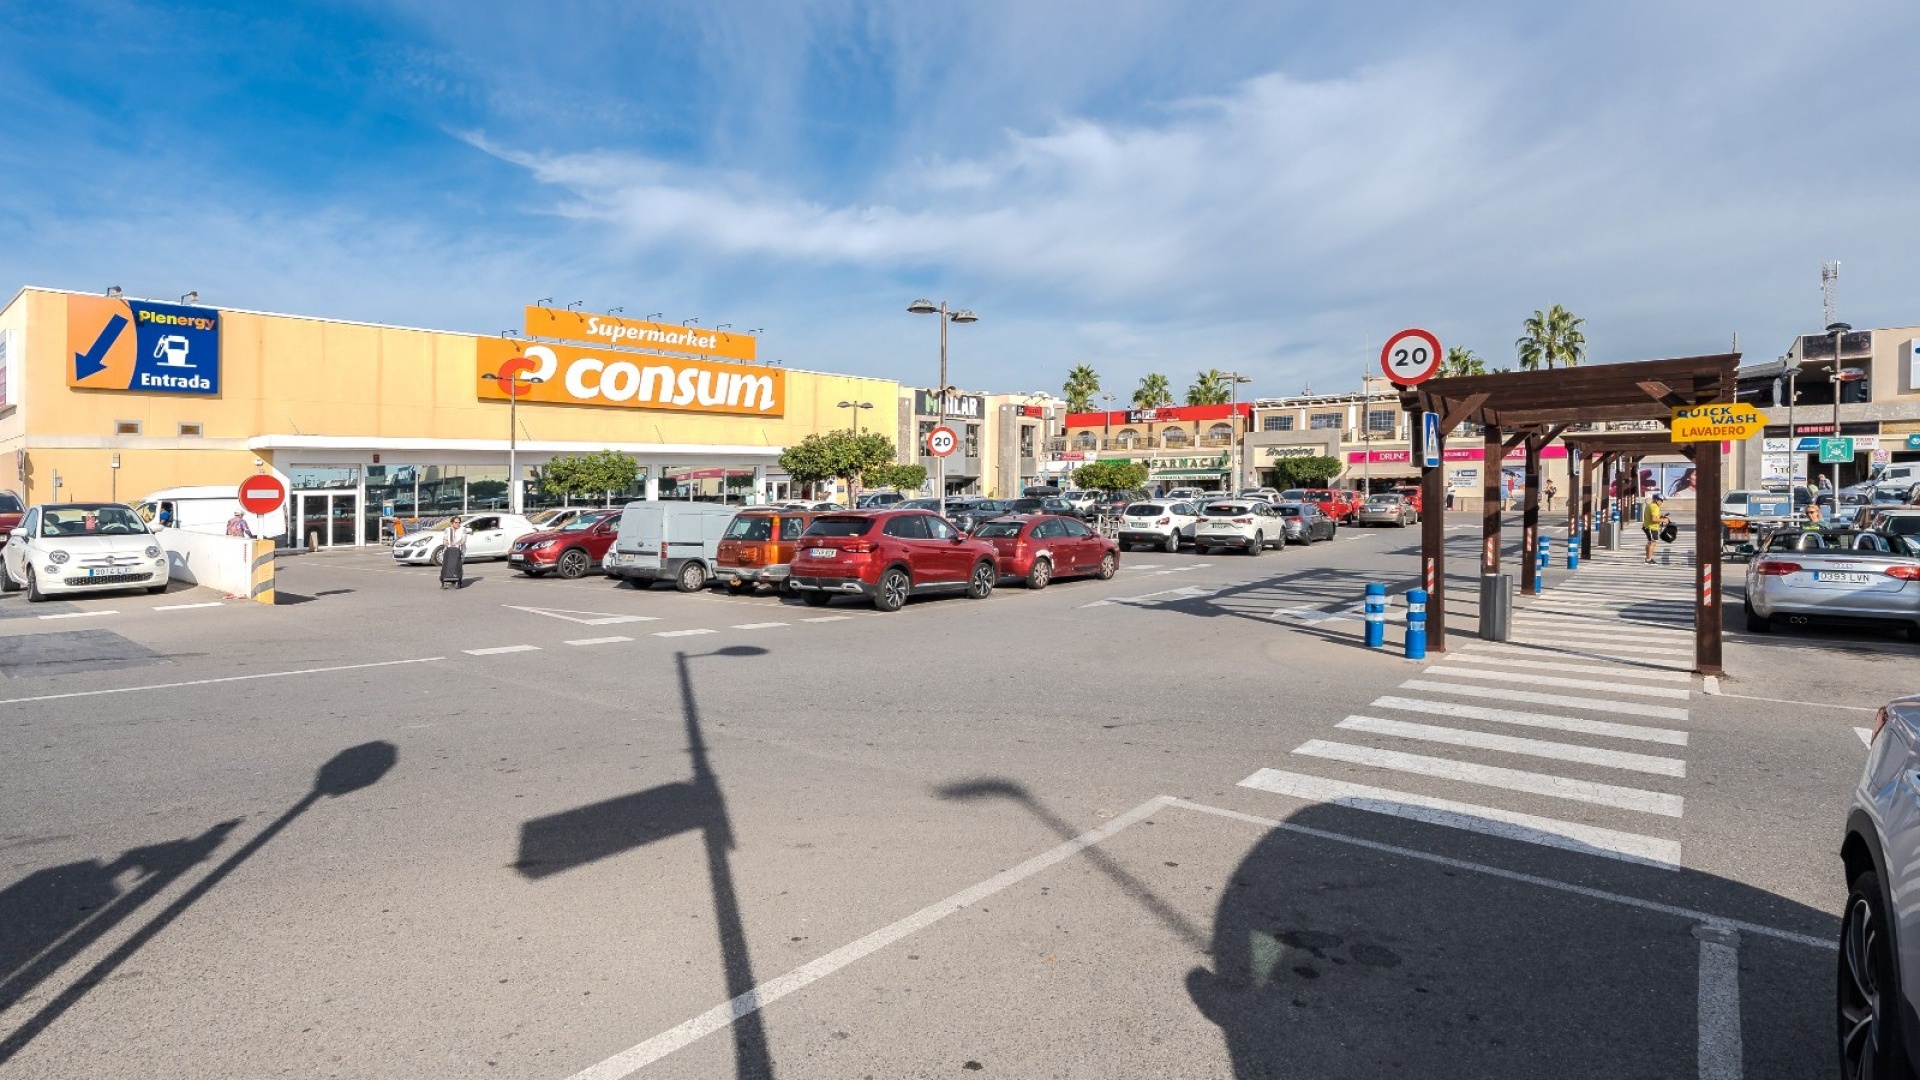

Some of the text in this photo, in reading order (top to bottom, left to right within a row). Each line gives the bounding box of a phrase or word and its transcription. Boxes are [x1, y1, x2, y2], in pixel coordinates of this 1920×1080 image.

[139, 310, 215, 330] Plenergy
[586, 317, 717, 349] Supermarket
[1395, 348, 1427, 366] 20
[141, 373, 210, 389] Entrada
[565, 358, 775, 410] consum
[1677, 406, 1732, 418] QUICK
[1710, 413, 1758, 425] WASH
[1682, 425, 1746, 438] LAVADERO
[934, 437, 950, 446] 20
[1151, 457, 1224, 469] FARMACIA
